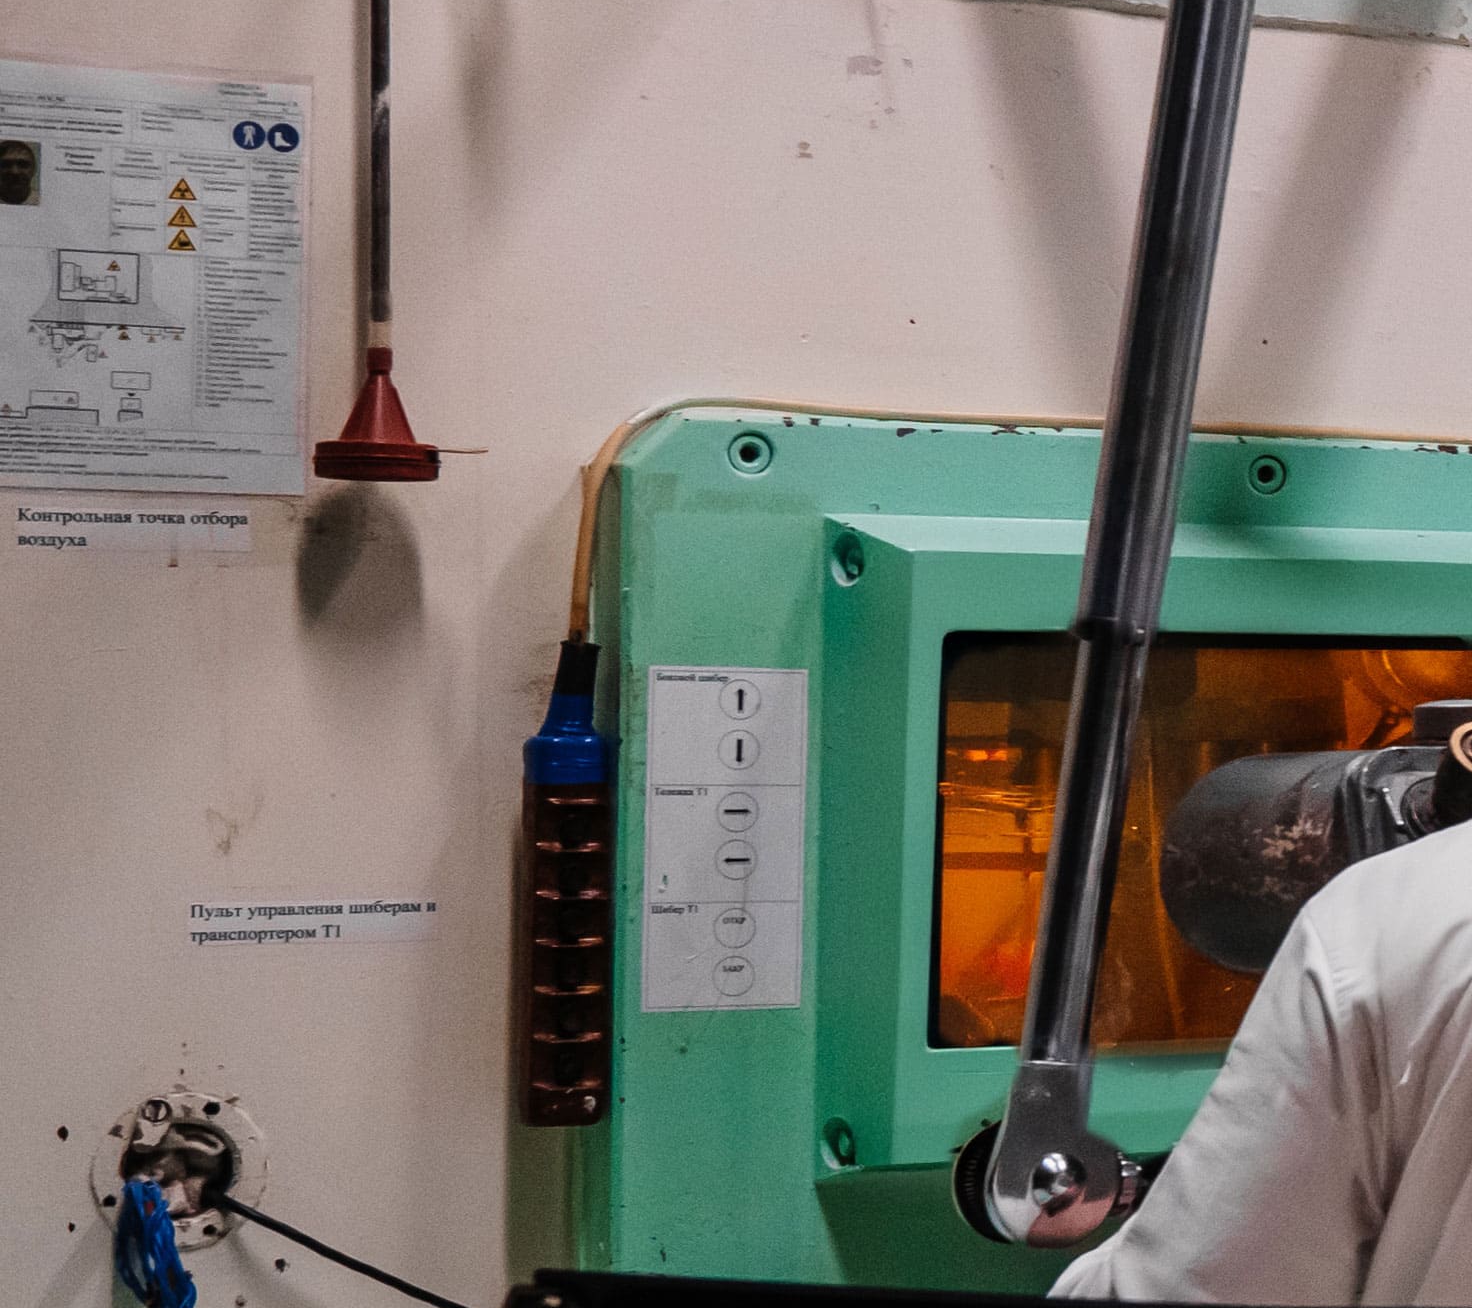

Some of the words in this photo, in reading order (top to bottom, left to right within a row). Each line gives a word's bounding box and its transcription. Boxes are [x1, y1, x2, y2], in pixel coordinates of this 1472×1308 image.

[17, 507, 132, 526] Контрольная
[137, 512, 185, 525] точка
[190, 510, 248, 529] отбора
[17, 534, 87, 550] воздуха
[190, 903, 243, 921] Пульт
[247, 904, 344, 921] управления
[348, 899, 422, 917] шиберам
[426, 901, 437, 913] и
[190, 926, 316, 945] транспортером
[321, 924, 342, 939] Т1
